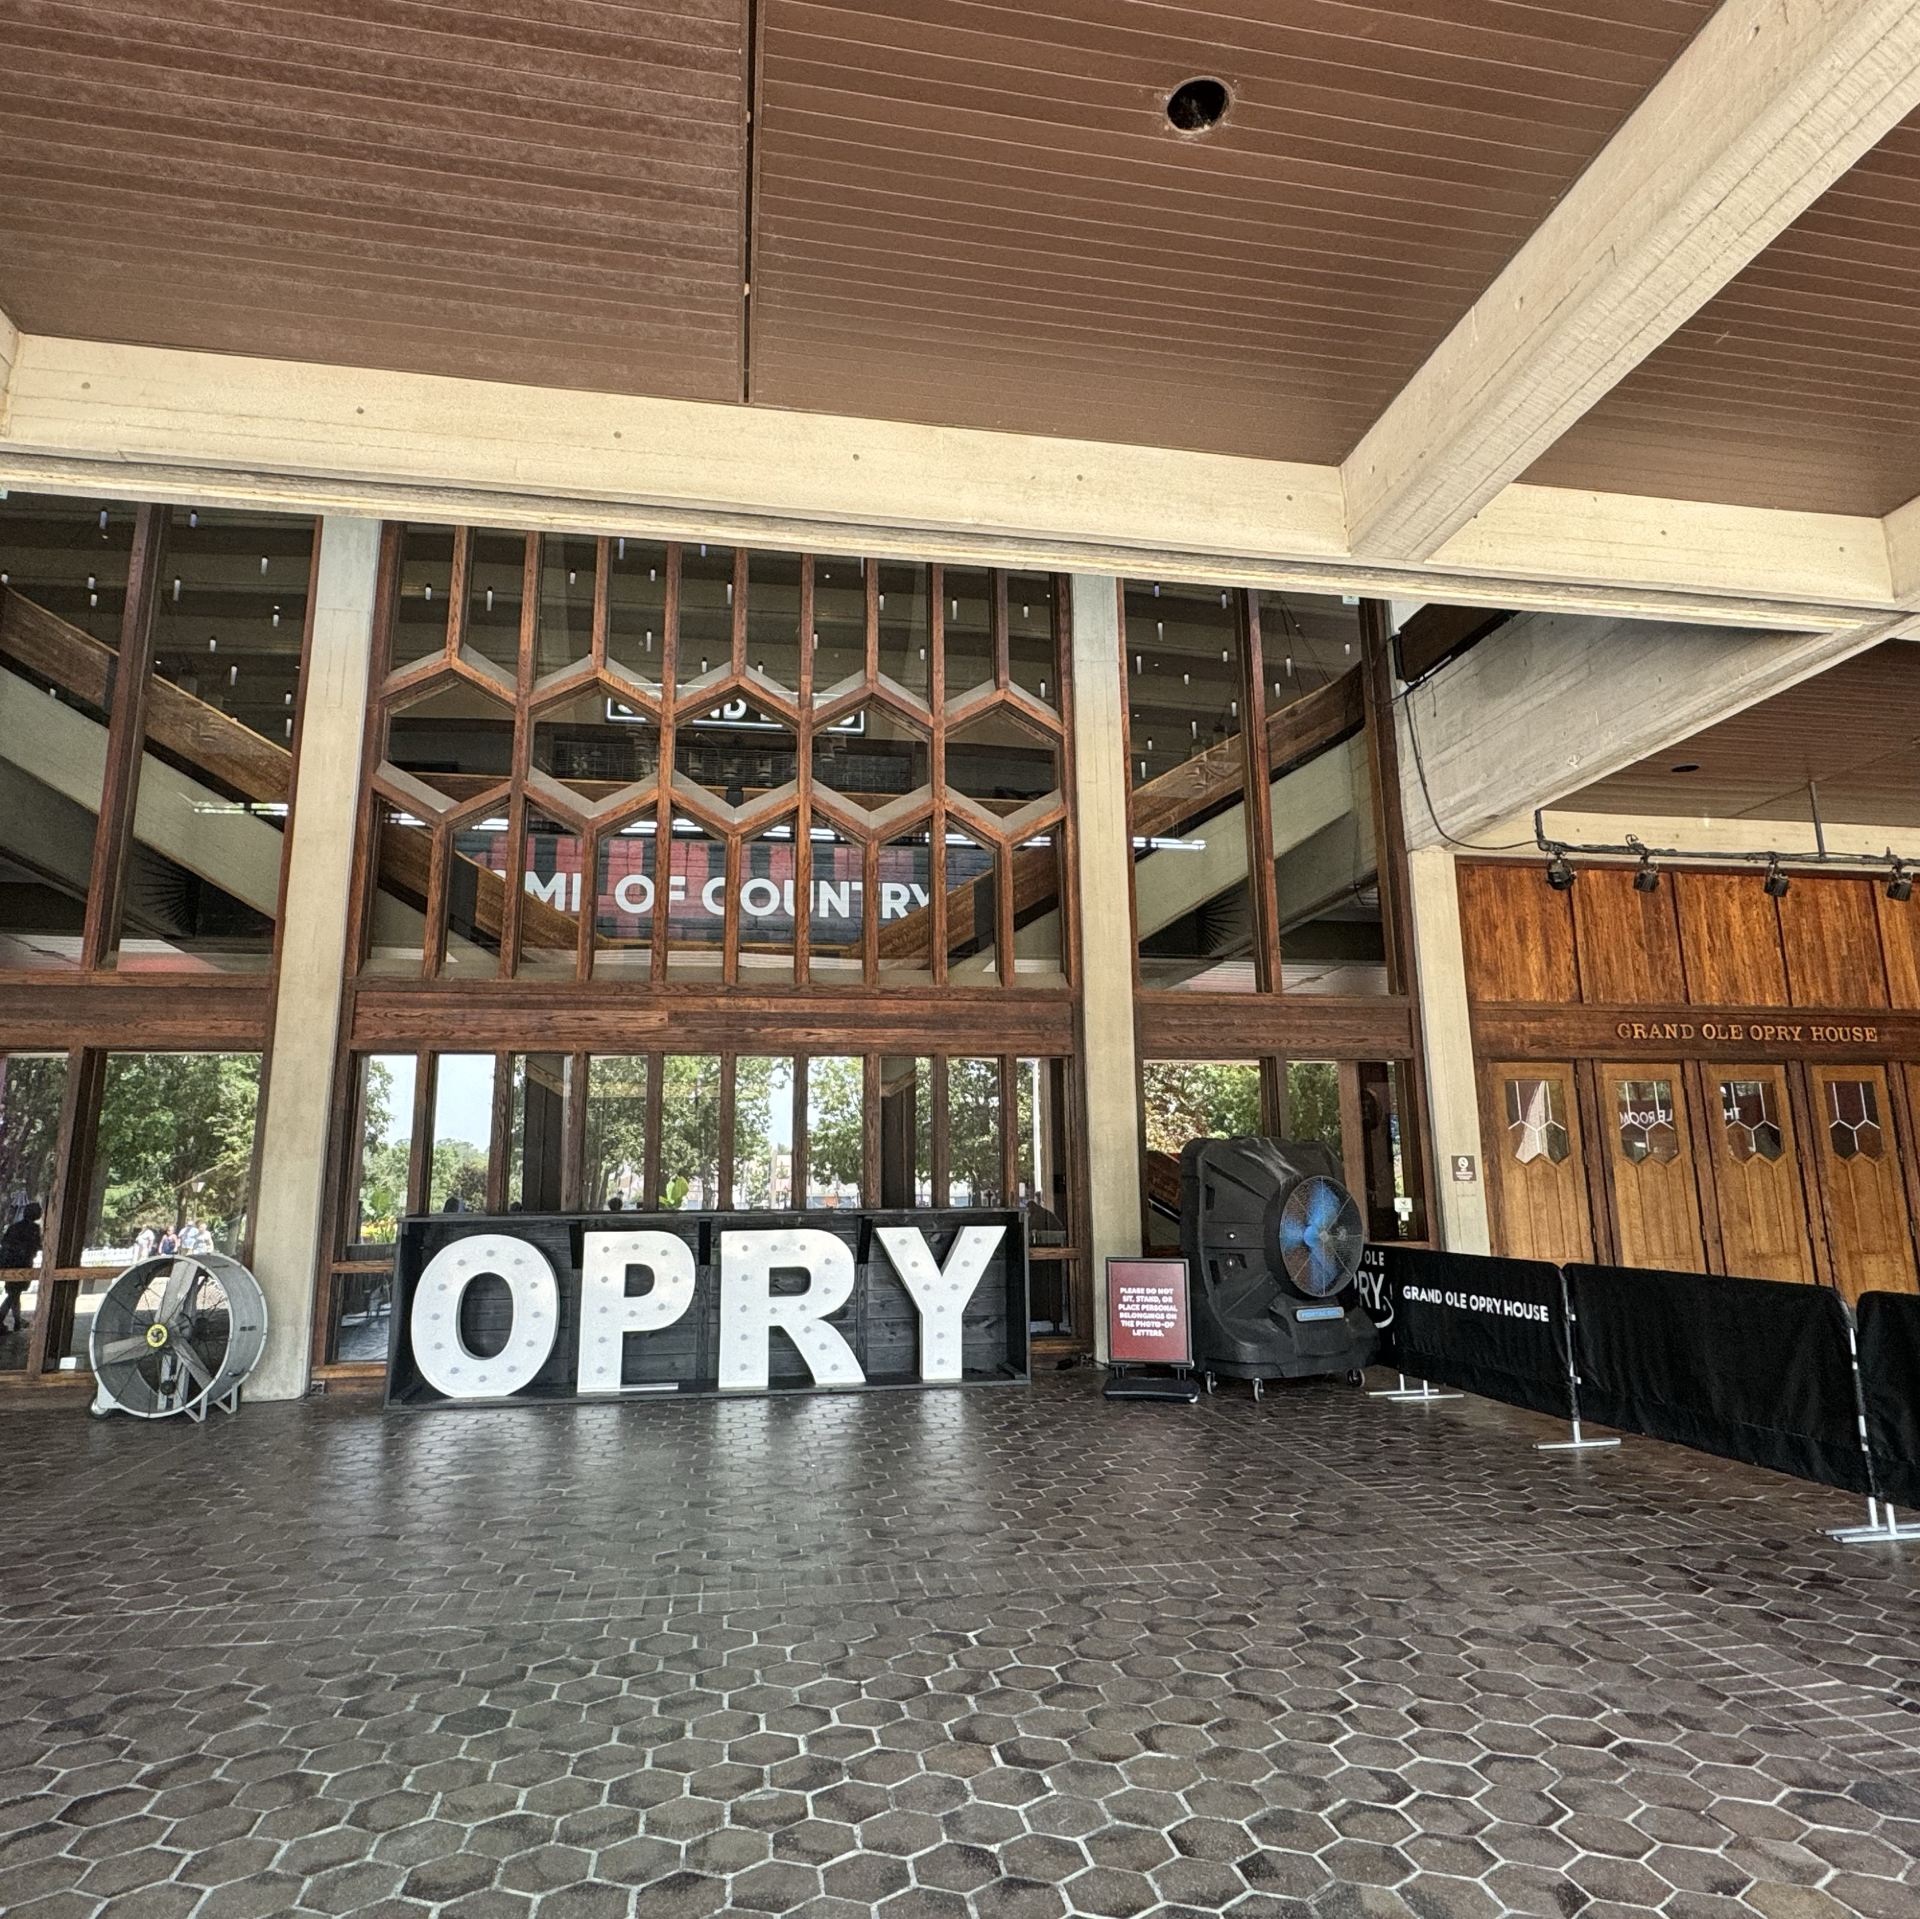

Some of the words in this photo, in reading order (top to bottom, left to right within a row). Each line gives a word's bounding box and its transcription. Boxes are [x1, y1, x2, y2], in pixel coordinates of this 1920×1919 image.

[615, 874, 686, 914] OF
[1617, 1023, 1695, 1040] GRAND
[1702, 1023, 1743, 1041] OLE
[1750, 1024, 1801, 1042] OPRY
[1810, 1026, 1878, 1042] HOUSE
[1365, 1250, 1385, 1266] OLE
[1120, 1287, 1145, 1295] PLEASE
[411, 1225, 1007, 1399] OPRY
[1141, 1304, 1178, 1312] PERSONAL
[1402, 1285, 1443, 1305] GRAND
[1445, 1291, 1468, 1309] OLE
[1469, 1295, 1502, 1315] OPRY
[1504, 1301, 1550, 1323] HOUSE
[1119, 1312, 1165, 1320] BELONGINGS
[1120, 1320, 1135, 1328] THE
